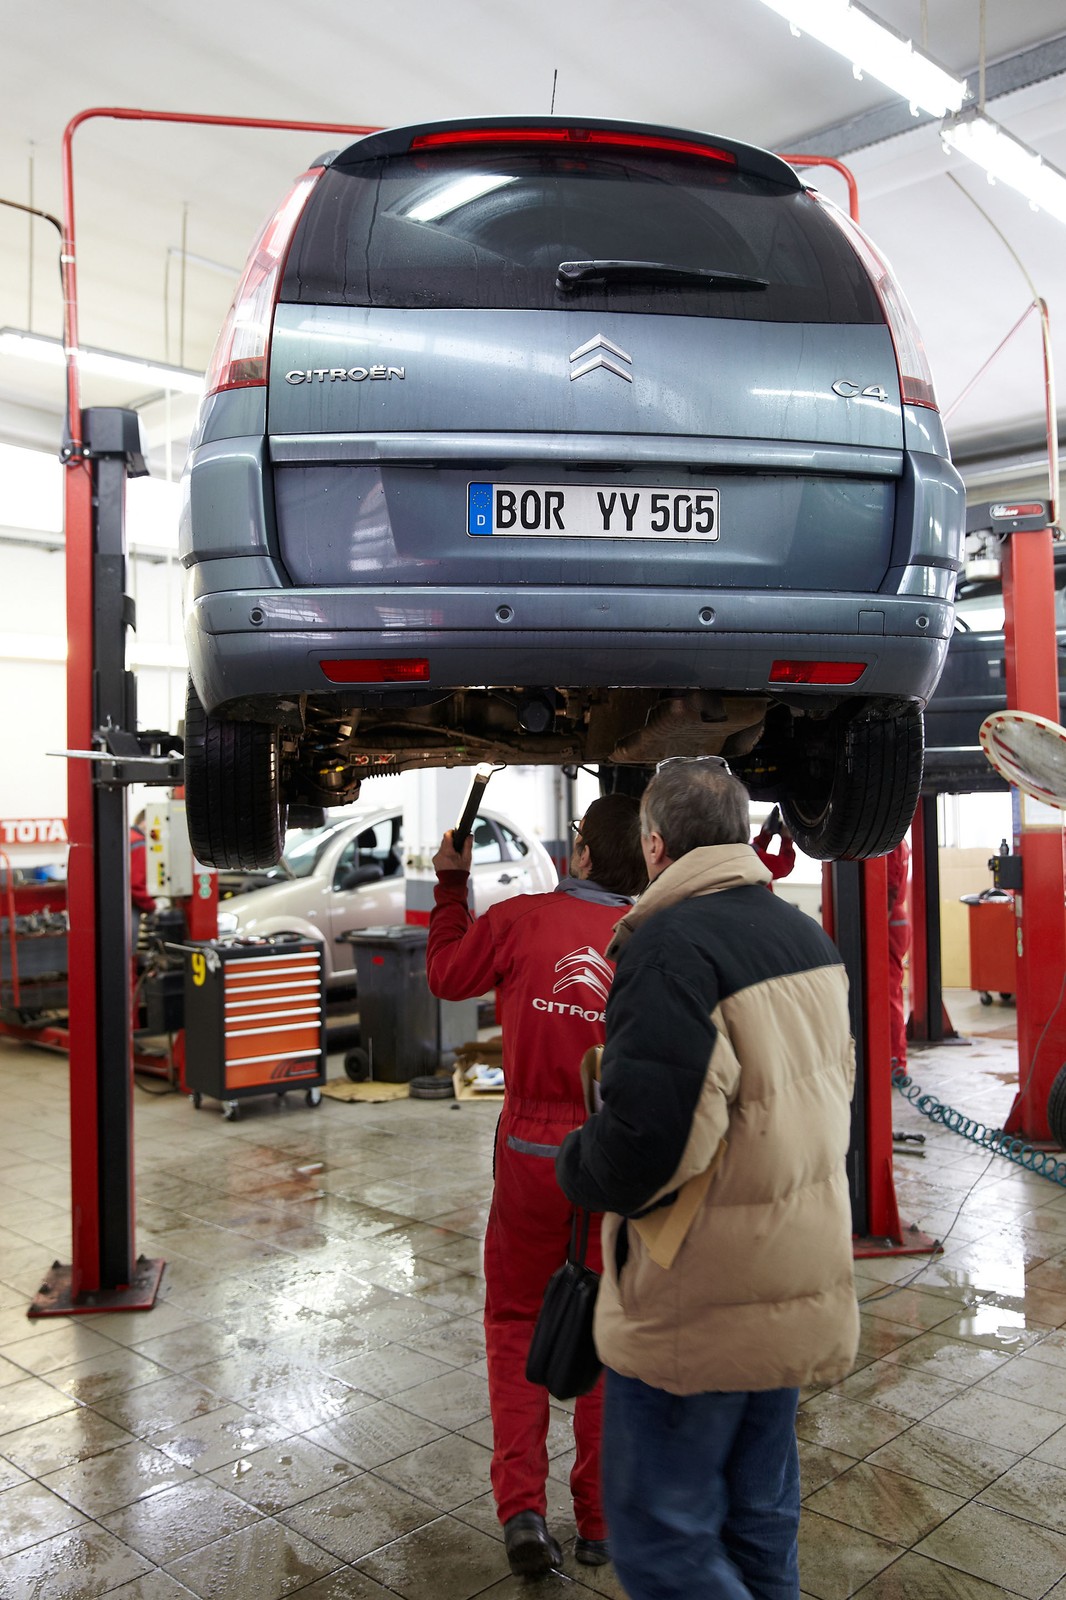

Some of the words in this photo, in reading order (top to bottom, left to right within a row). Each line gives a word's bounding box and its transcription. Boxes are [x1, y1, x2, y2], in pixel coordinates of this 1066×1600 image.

[285, 364, 405, 385] CITROËN
[831, 380, 888, 401] C4
[476, 514, 486, 526] D
[496, 489, 565, 530] BOR
[597, 491, 640, 531] YY
[650, 494, 714, 533] 505
[1, 819, 68, 843] TOTA
[191, 952, 206, 987] 9
